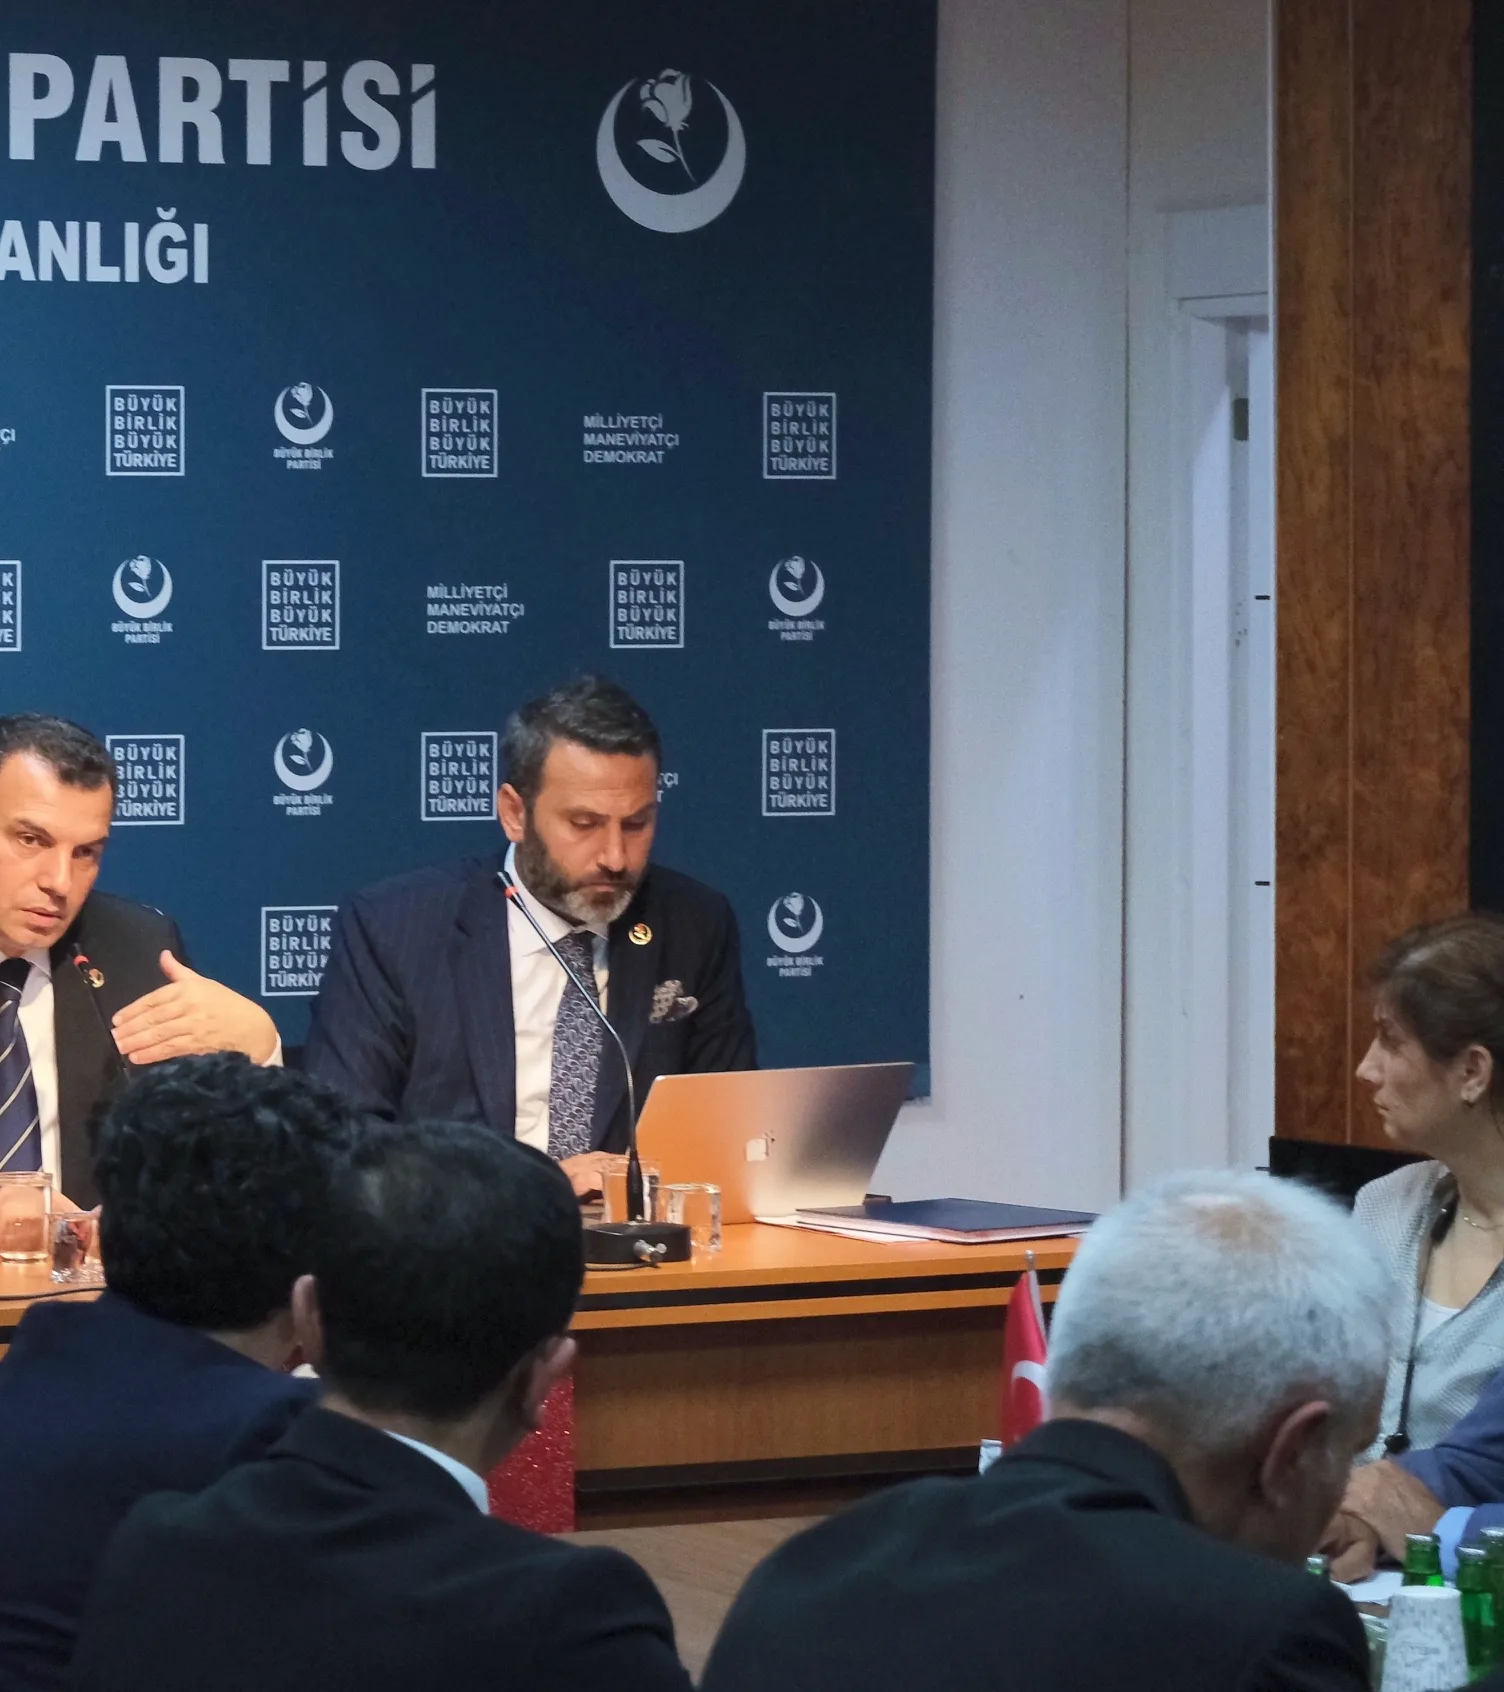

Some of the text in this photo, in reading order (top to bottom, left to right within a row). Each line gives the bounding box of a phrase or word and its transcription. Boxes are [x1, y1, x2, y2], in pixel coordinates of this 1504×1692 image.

[9, 53, 435, 170] PARTİSİ
[114, 394, 177, 412] BÜYÜK
[430, 397, 490, 414] BÜYÜK
[771, 401, 829, 417] BÜYÜK
[114, 413, 177, 430] BİRLİK
[430, 415, 490, 432] BİRLİK
[584, 413, 663, 431] MİLLİYETÇİ
[771, 419, 829, 435] BİRLİK
[114, 431, 177, 449] BÜYÜK
[430, 434, 490, 451] BÜYÜK
[584, 431, 679, 448] MANEVİYATÇI
[771, 436, 829, 453] BÜYÜK
[113, 450, 177, 467] TÜRKİYE
[429, 452, 490, 469] TÜRKİYE
[583, 450, 665, 463] DEMOKRAT
[770, 454, 829, 471] TÜRKİYE
[270, 569, 332, 586] BÜYÜK
[618, 569, 677, 586] BÜYÜK
[270, 587, 332, 604] BİRLİK
[427, 583, 508, 601] MİLLİYETÇİ
[618, 587, 677, 604] BİRLİK
[270, 606, 332, 623] BÜYÜK
[427, 601, 524, 618] MANEVİYATÇI
[618, 605, 677, 622] BÜYÜK
[269, 624, 332, 641] TÜRKİYE
[427, 621, 510, 634] DEMOKRAT
[617, 623, 677, 640] TÜRKİYE
[113, 743, 177, 761] BÜYÜK
[429, 740, 490, 757] BÜYÜK
[770, 737, 828, 754] BÜYÜK
[429, 759, 490, 776] BİRLİK
[770, 755, 828, 772] BİRLİK
[429, 777, 490, 794] BÜYÜK
[770, 773, 828, 790] BÜYÜK
[428, 795, 490, 812] TÜRKİYE
[769, 791, 828, 808] TÜRKİYE
[269, 914, 332, 932] BÜYÜK
[269, 933, 332, 951] BİRLİK
[268, 969, 324, 987] TÜRKİY
